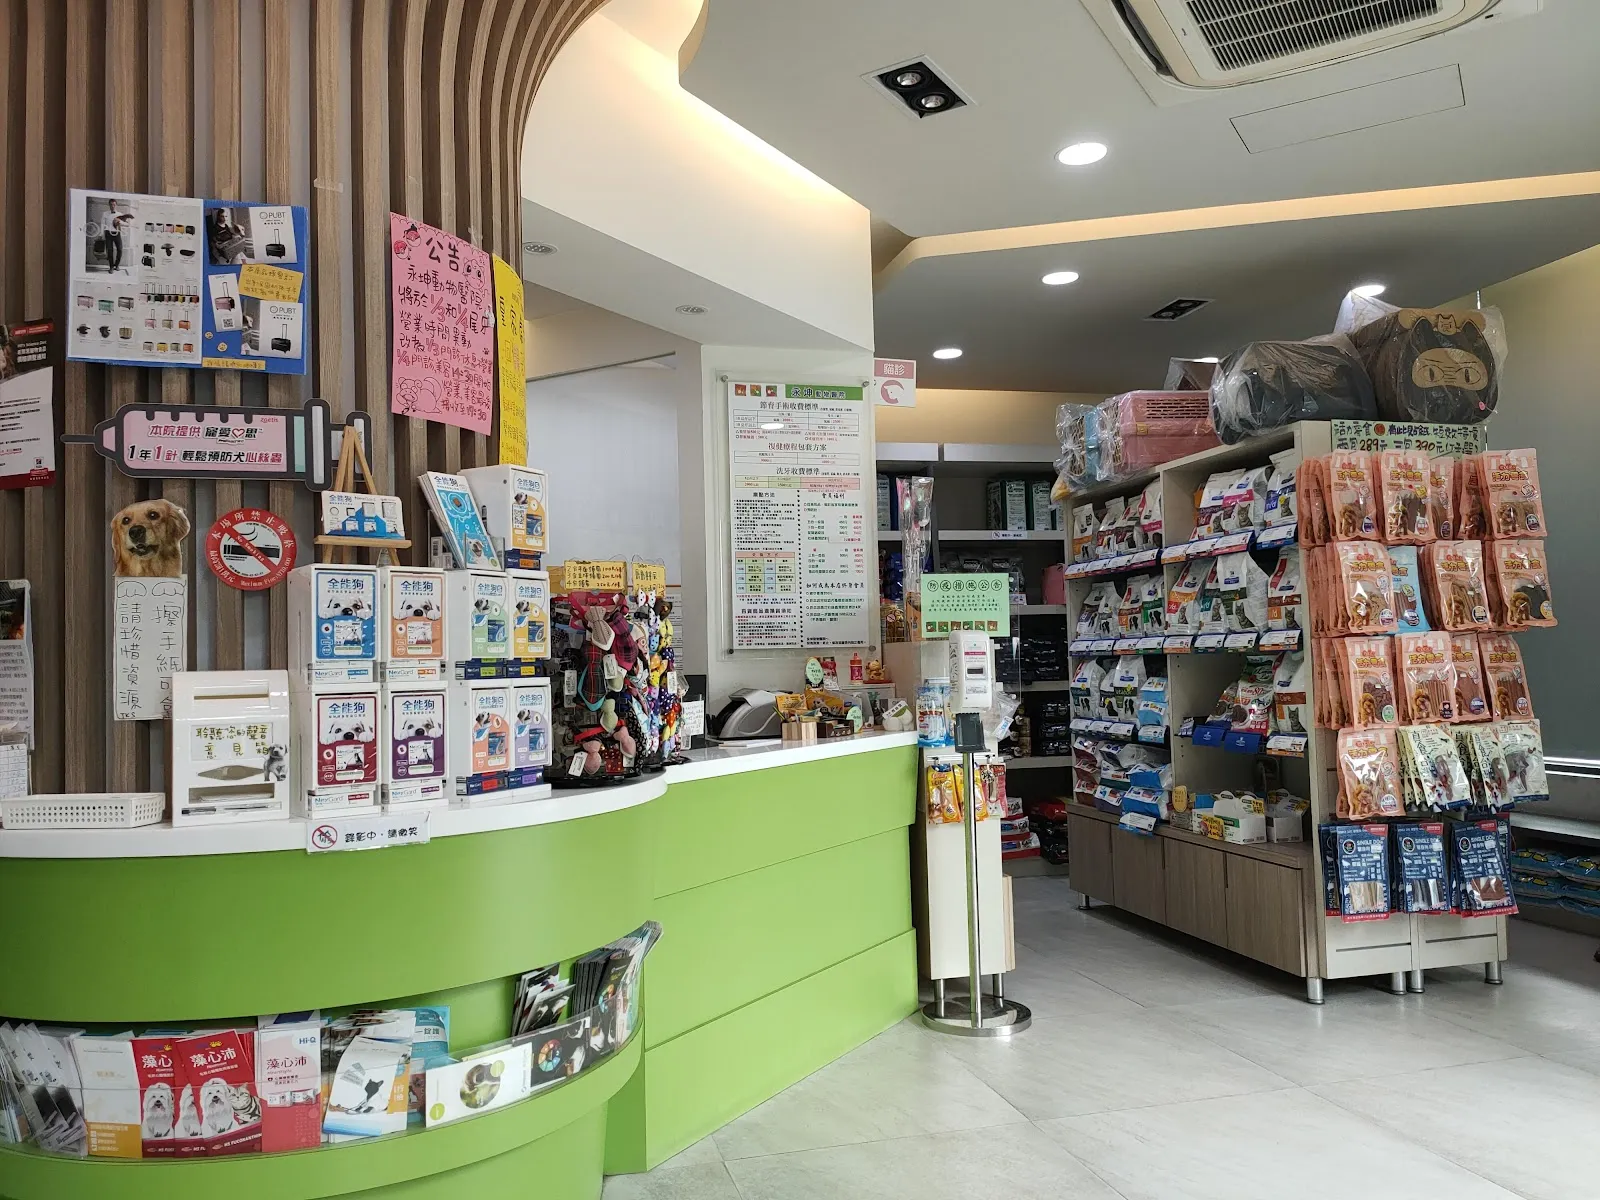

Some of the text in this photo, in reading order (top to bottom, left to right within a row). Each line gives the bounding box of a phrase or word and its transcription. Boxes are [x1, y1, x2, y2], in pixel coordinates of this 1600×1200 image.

[268, 211, 286, 219] PUBT
[426, 237, 460, 272] 公告
[883, 363, 905, 376] 貓診
[150, 425, 201, 438] 本院提供
[1333, 421, 1372, 437] 活力零食
[776, 467, 820, 475] 洗牙收費標準
[434, 475, 458, 487] 全能狗
[244, 543, 265, 562] Smoking
[327, 577, 364, 590] 全能狗
[400, 580, 433, 592] 全能狗
[119, 602, 143, 710] 請珍惜資源
[328, 702, 366, 714] 全能狗
[402, 699, 435, 711] 全能狗
[196, 724, 268, 741] 聆聽您的聲音
[204, 742, 269, 760] 意見箱
[298, 1036, 317, 1045] Hi-Q
[141, 1054, 173, 1069] 藻心
[190, 1047, 237, 1068] 藻心沛
[266, 1055, 307, 1070] 藻心沛
